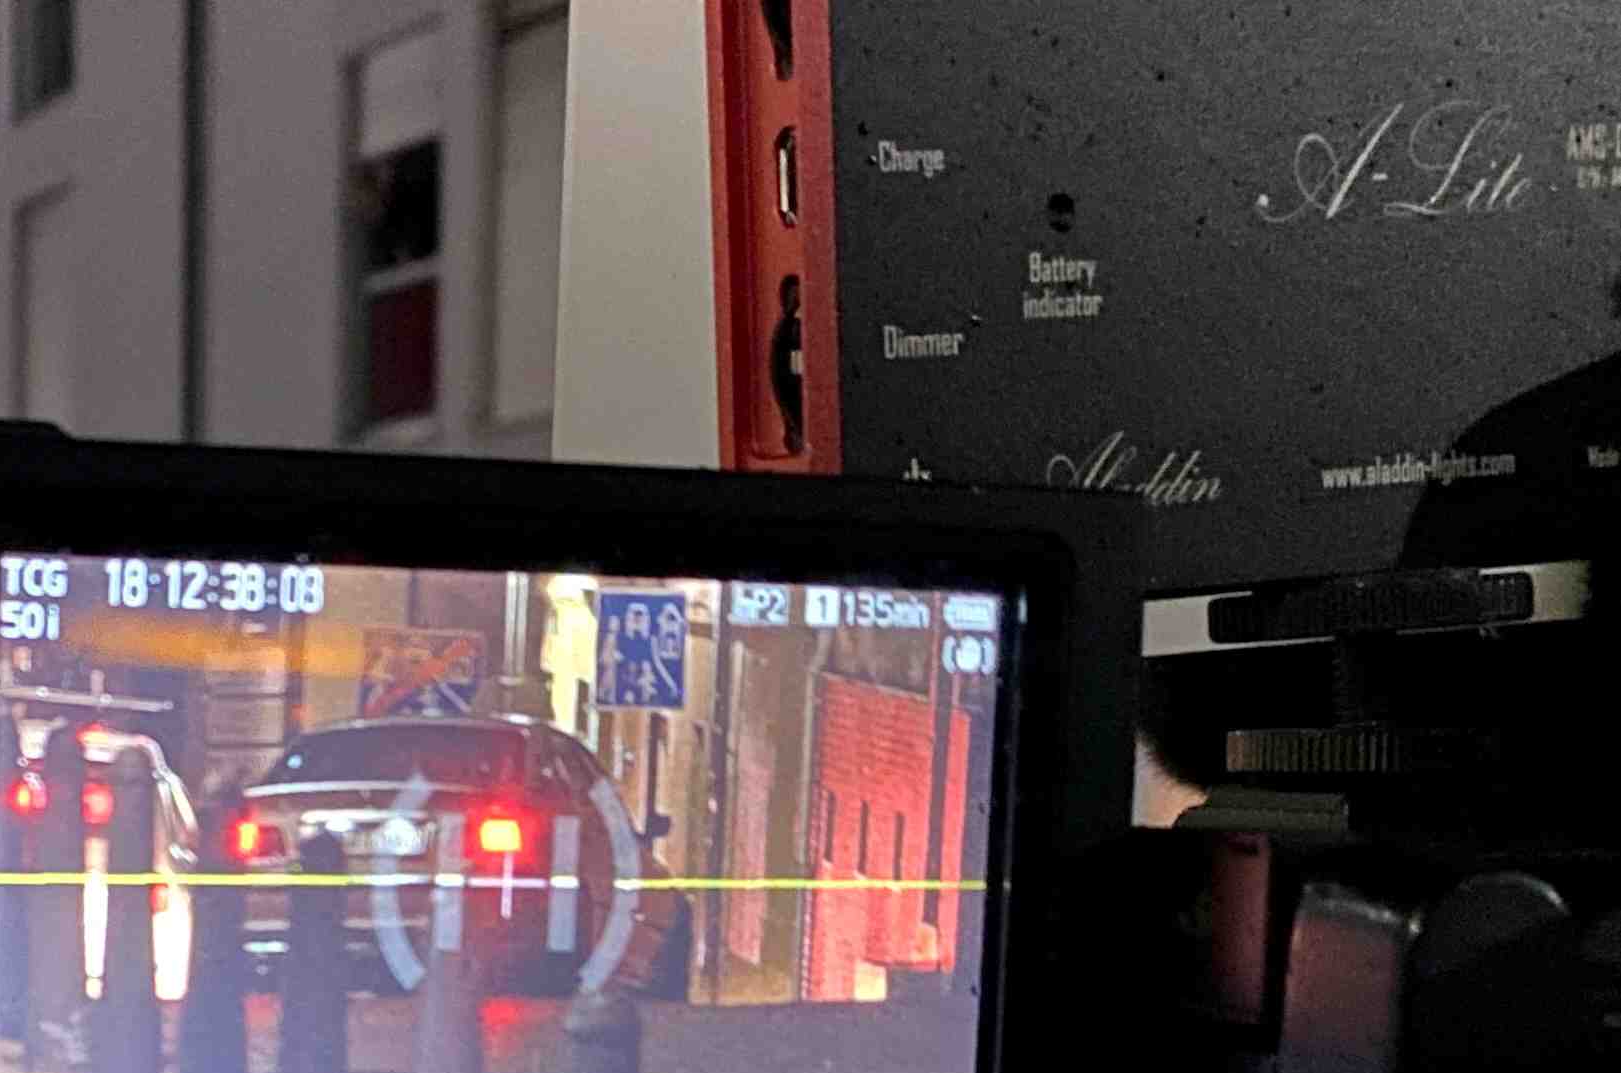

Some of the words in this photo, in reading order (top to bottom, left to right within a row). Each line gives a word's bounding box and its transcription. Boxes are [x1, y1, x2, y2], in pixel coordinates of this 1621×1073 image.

[878, 140, 946, 179] Charge
[1029, 252, 1097, 288] Battery
[1023, 289, 1103, 319] indicator
[883, 325, 965, 360] Dimmer
[0, 557, 68, 597] TCG
[0, 601, 60, 640] 50i
